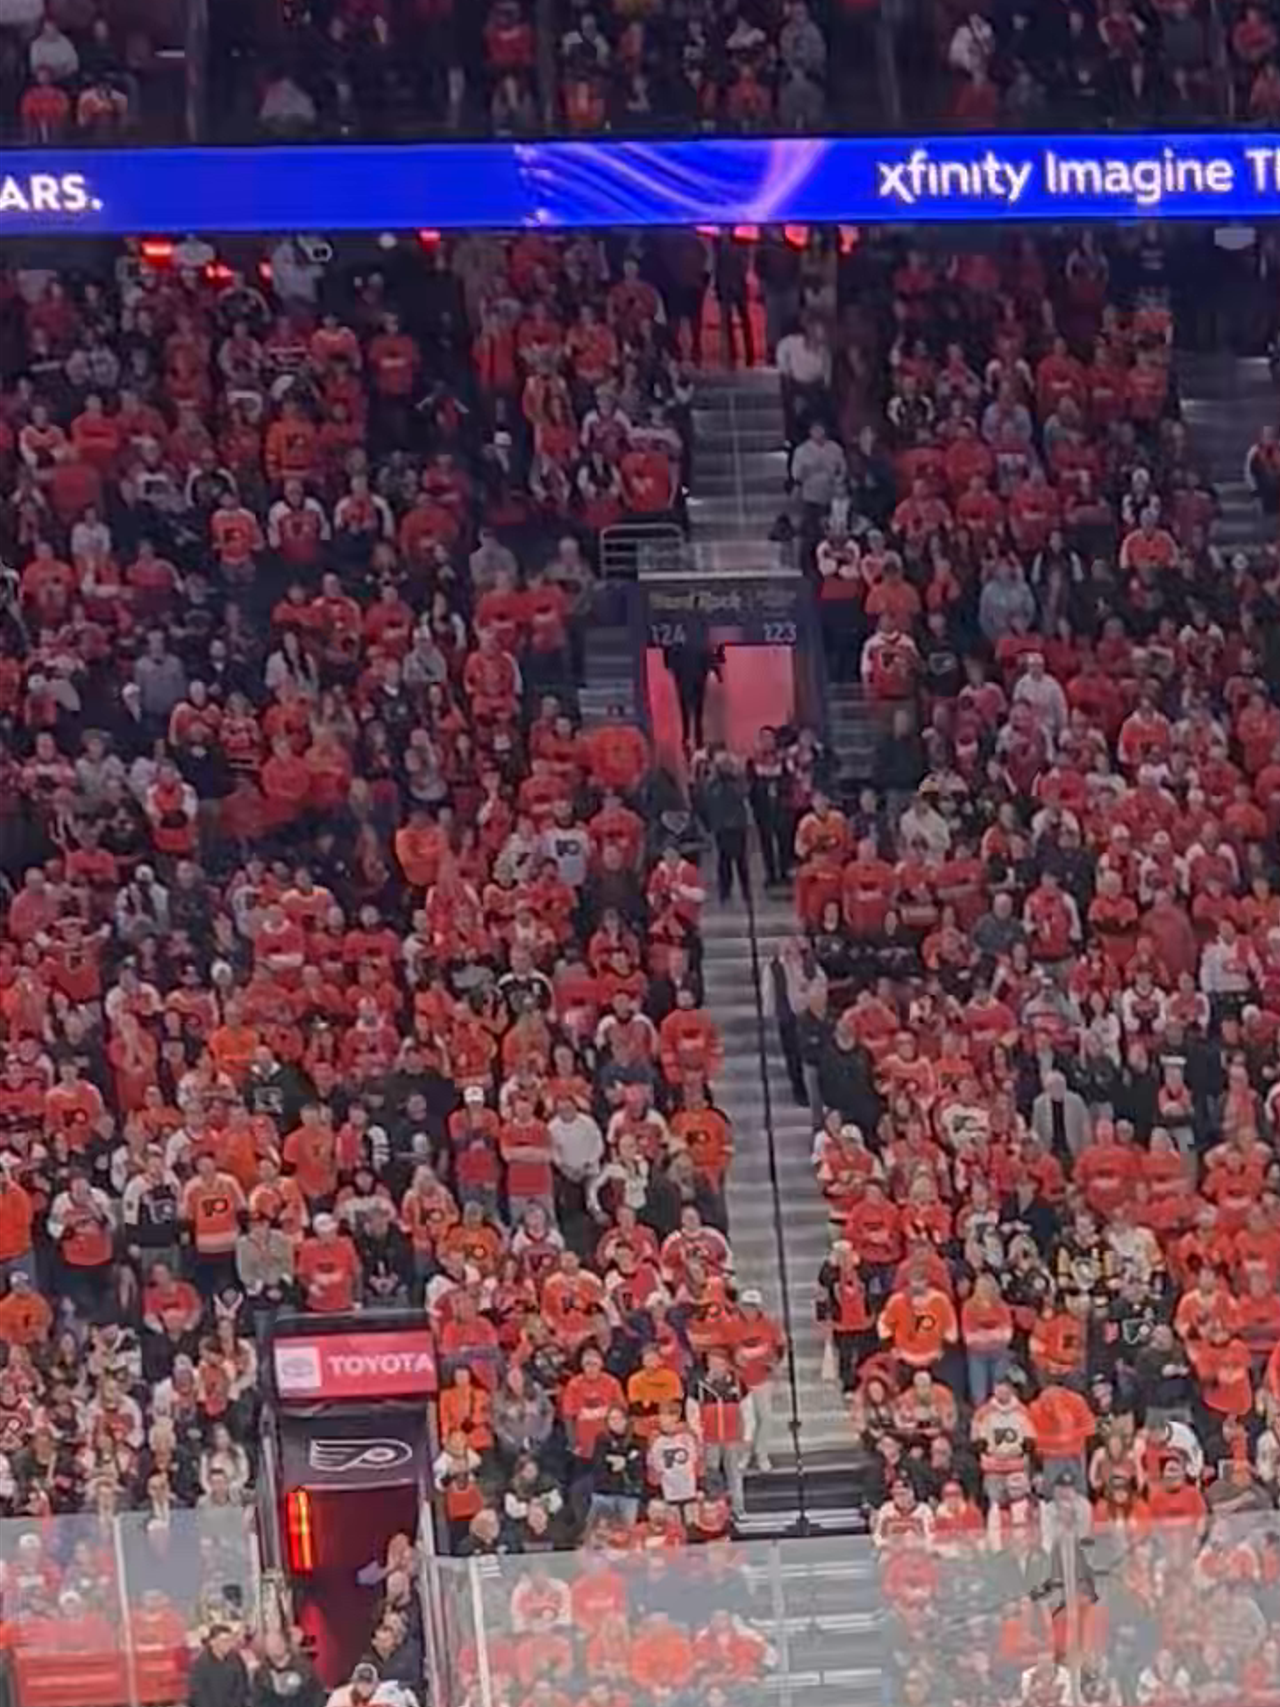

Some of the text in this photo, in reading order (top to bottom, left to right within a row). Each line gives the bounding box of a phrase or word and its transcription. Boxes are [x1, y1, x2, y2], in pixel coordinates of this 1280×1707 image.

[878, 155, 1034, 205] xfinity
[1045, 150, 1234, 206] Imagine
[327, 1351, 435, 1377] TOYOTA
